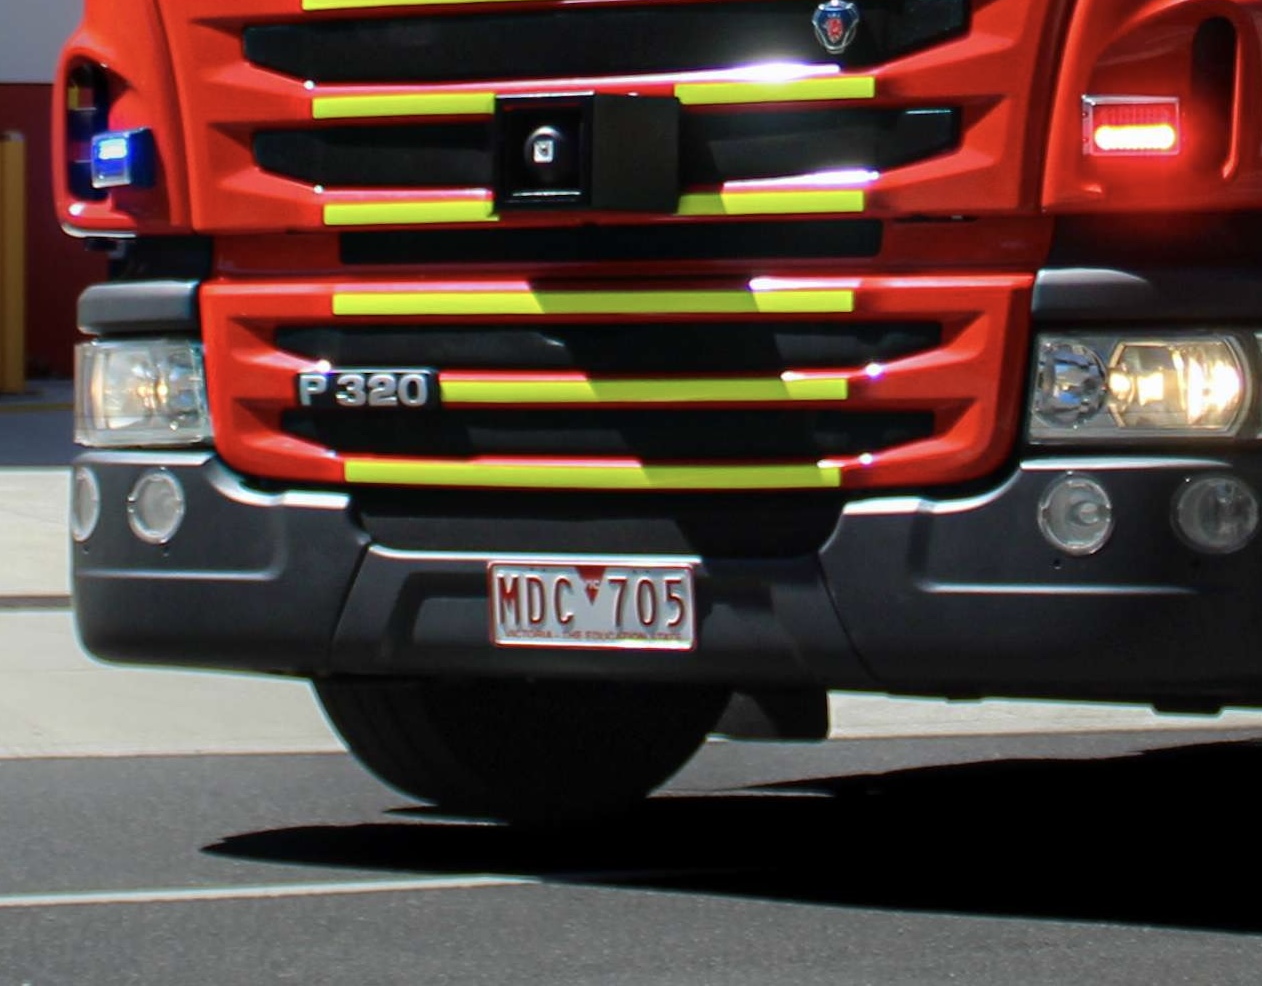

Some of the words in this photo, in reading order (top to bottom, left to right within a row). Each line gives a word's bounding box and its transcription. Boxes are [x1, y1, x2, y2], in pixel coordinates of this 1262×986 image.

[300, 374, 328, 406] P
[336, 374, 428, 407] 320
[496, 575, 575, 625] MDC
[607, 576, 686, 627] 705
